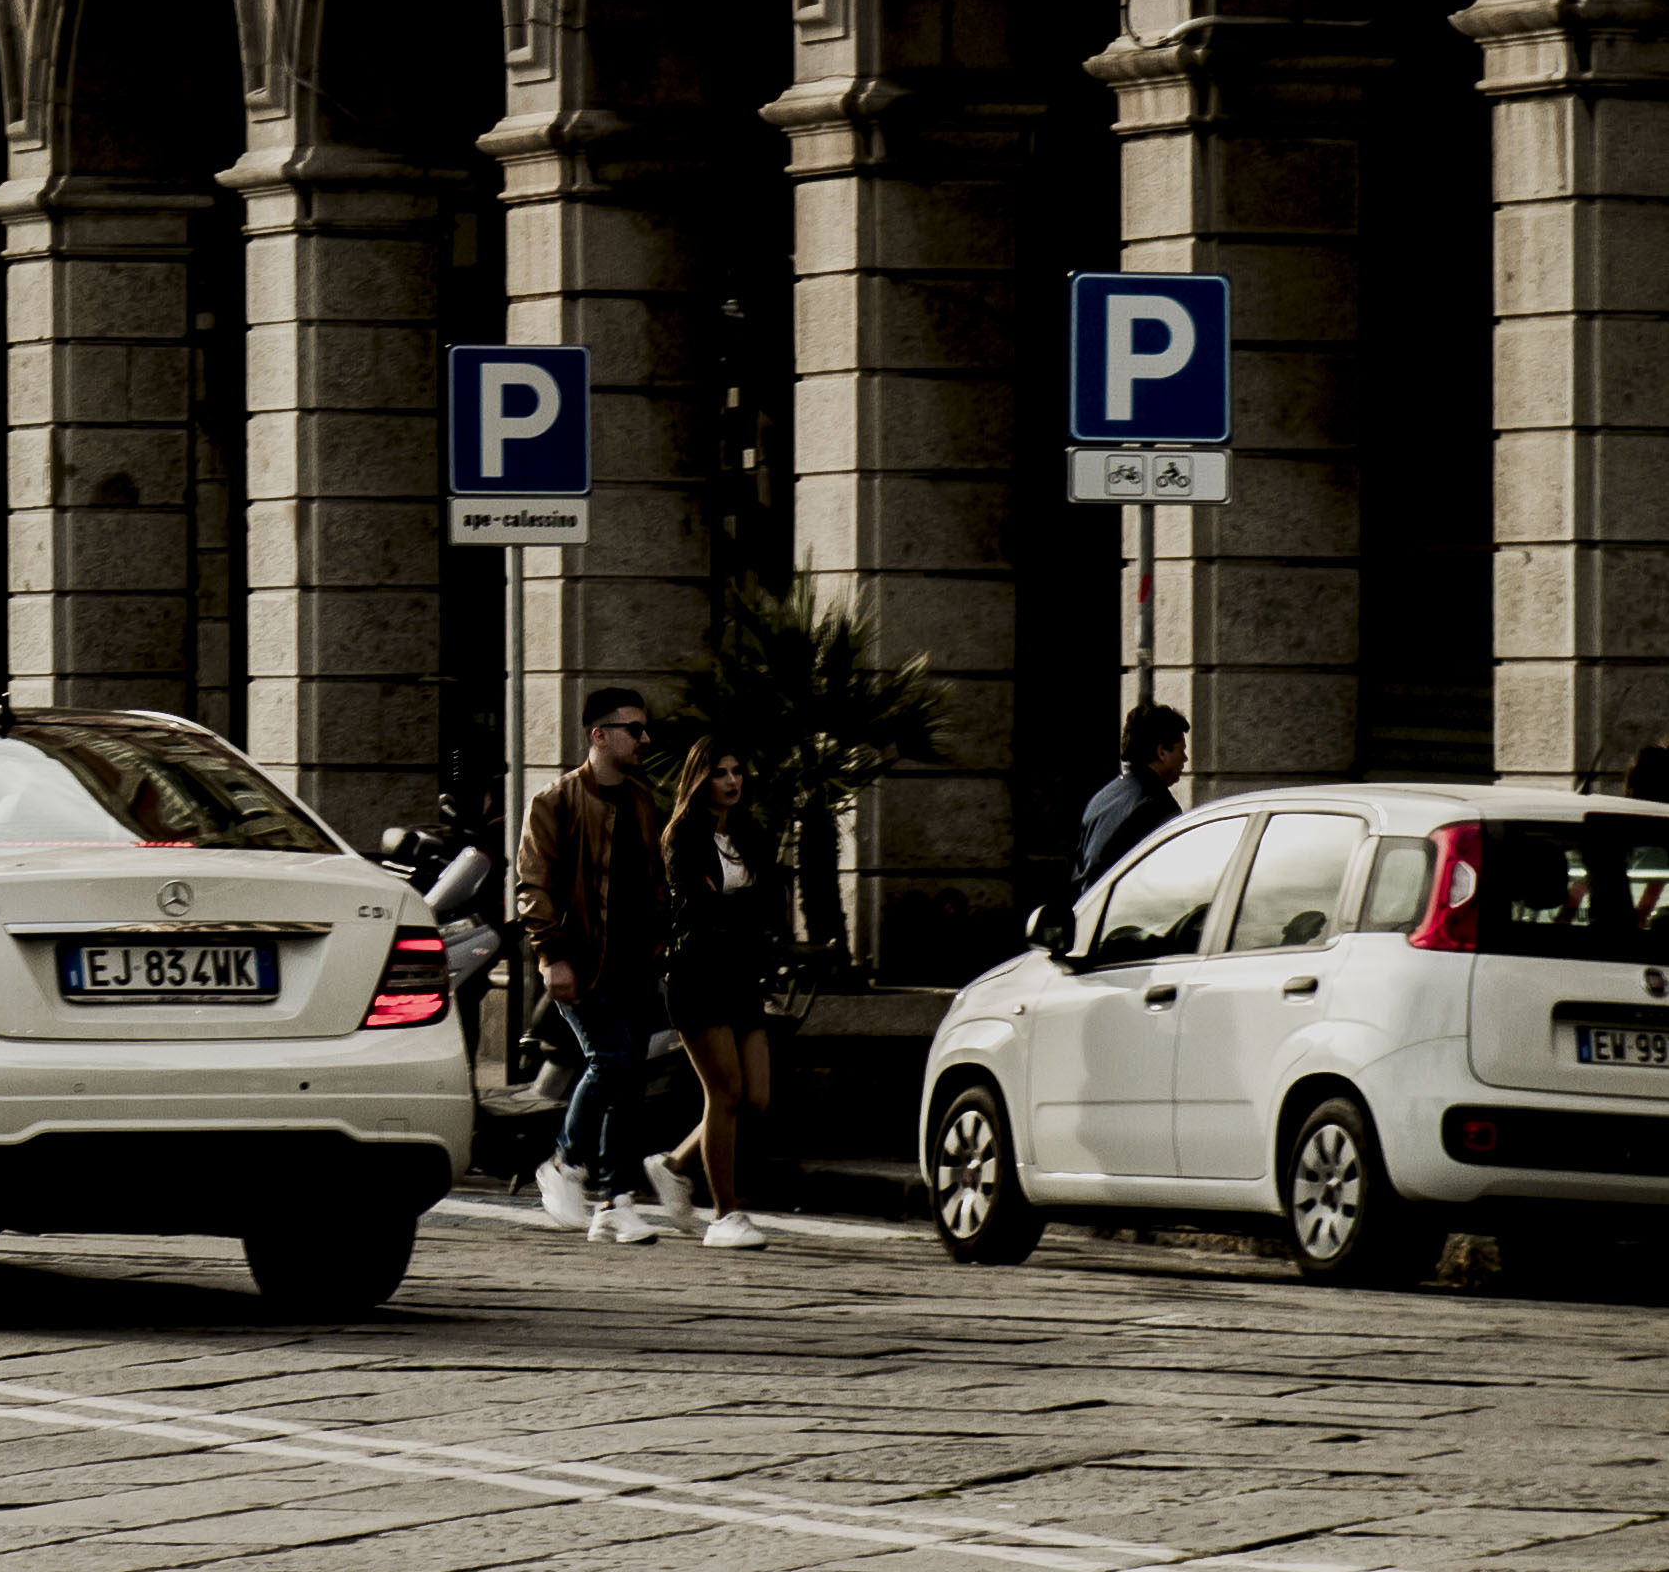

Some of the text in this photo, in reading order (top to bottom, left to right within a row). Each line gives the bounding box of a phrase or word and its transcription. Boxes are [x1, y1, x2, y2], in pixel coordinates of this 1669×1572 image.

[1105, 294, 1196, 421] P
[480, 362, 562, 478] P
[462, 509, 579, 531] ape-calessino
